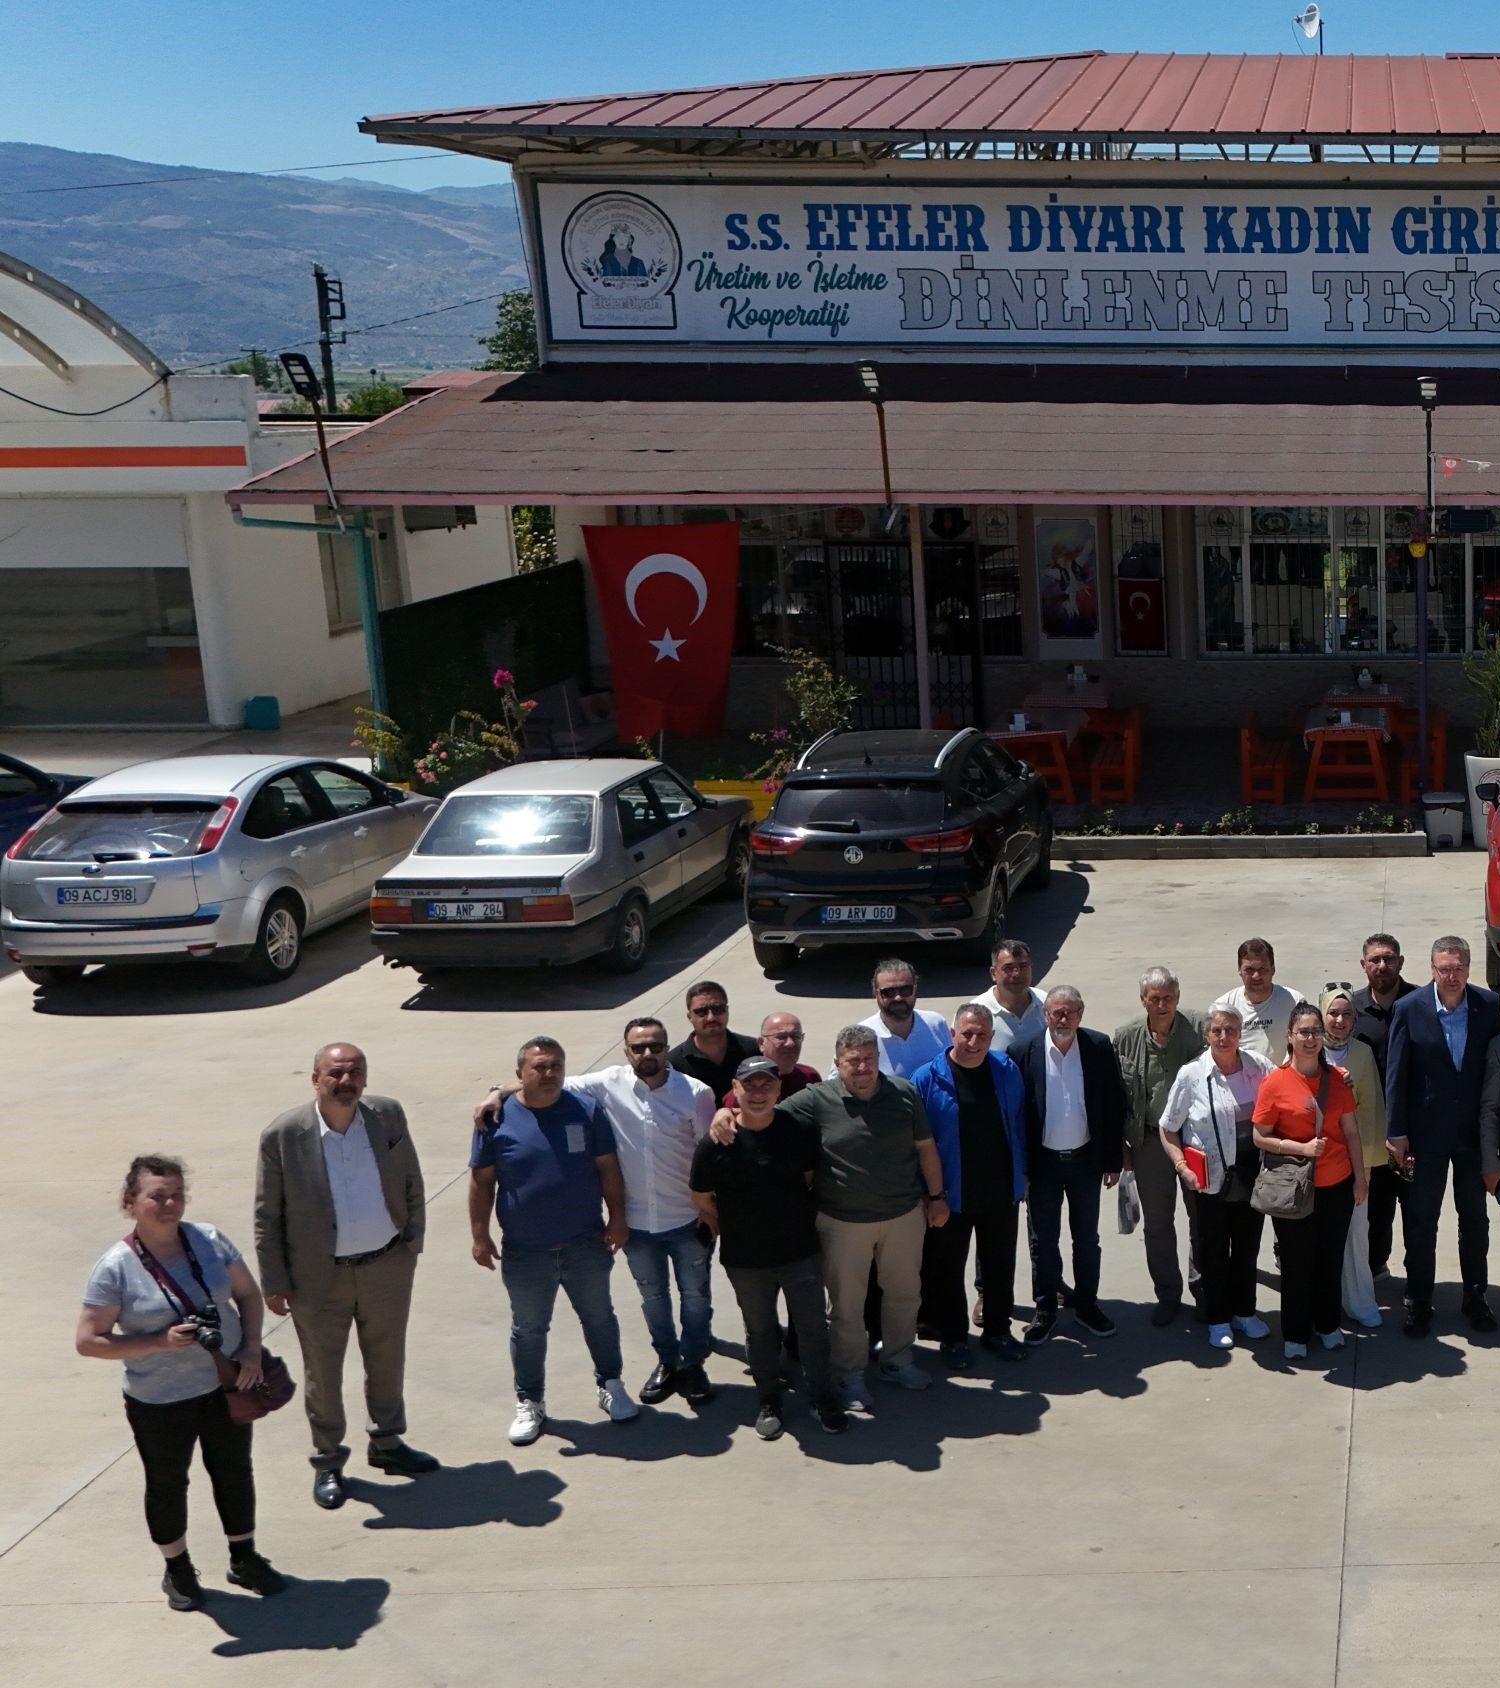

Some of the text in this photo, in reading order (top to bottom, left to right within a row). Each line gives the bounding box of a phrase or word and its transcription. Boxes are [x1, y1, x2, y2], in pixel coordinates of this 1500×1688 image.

[725, 213, 790, 251] S.S.
[803, 203, 989, 252] EFELER
[1006, 193, 1186, 253] DİYARI
[1203, 206, 1371, 254] KADIN
[687, 251, 888, 295] Üretim ve İşletme
[897, 255, 1289, 331] DİNLENME
[720, 296, 850, 339] Kooperatifi
[64, 889, 133, 902] 09 ACJ 918
[434, 904, 503, 916] 09 ANP 284
[828, 907, 893, 919] 09 ARV 060
